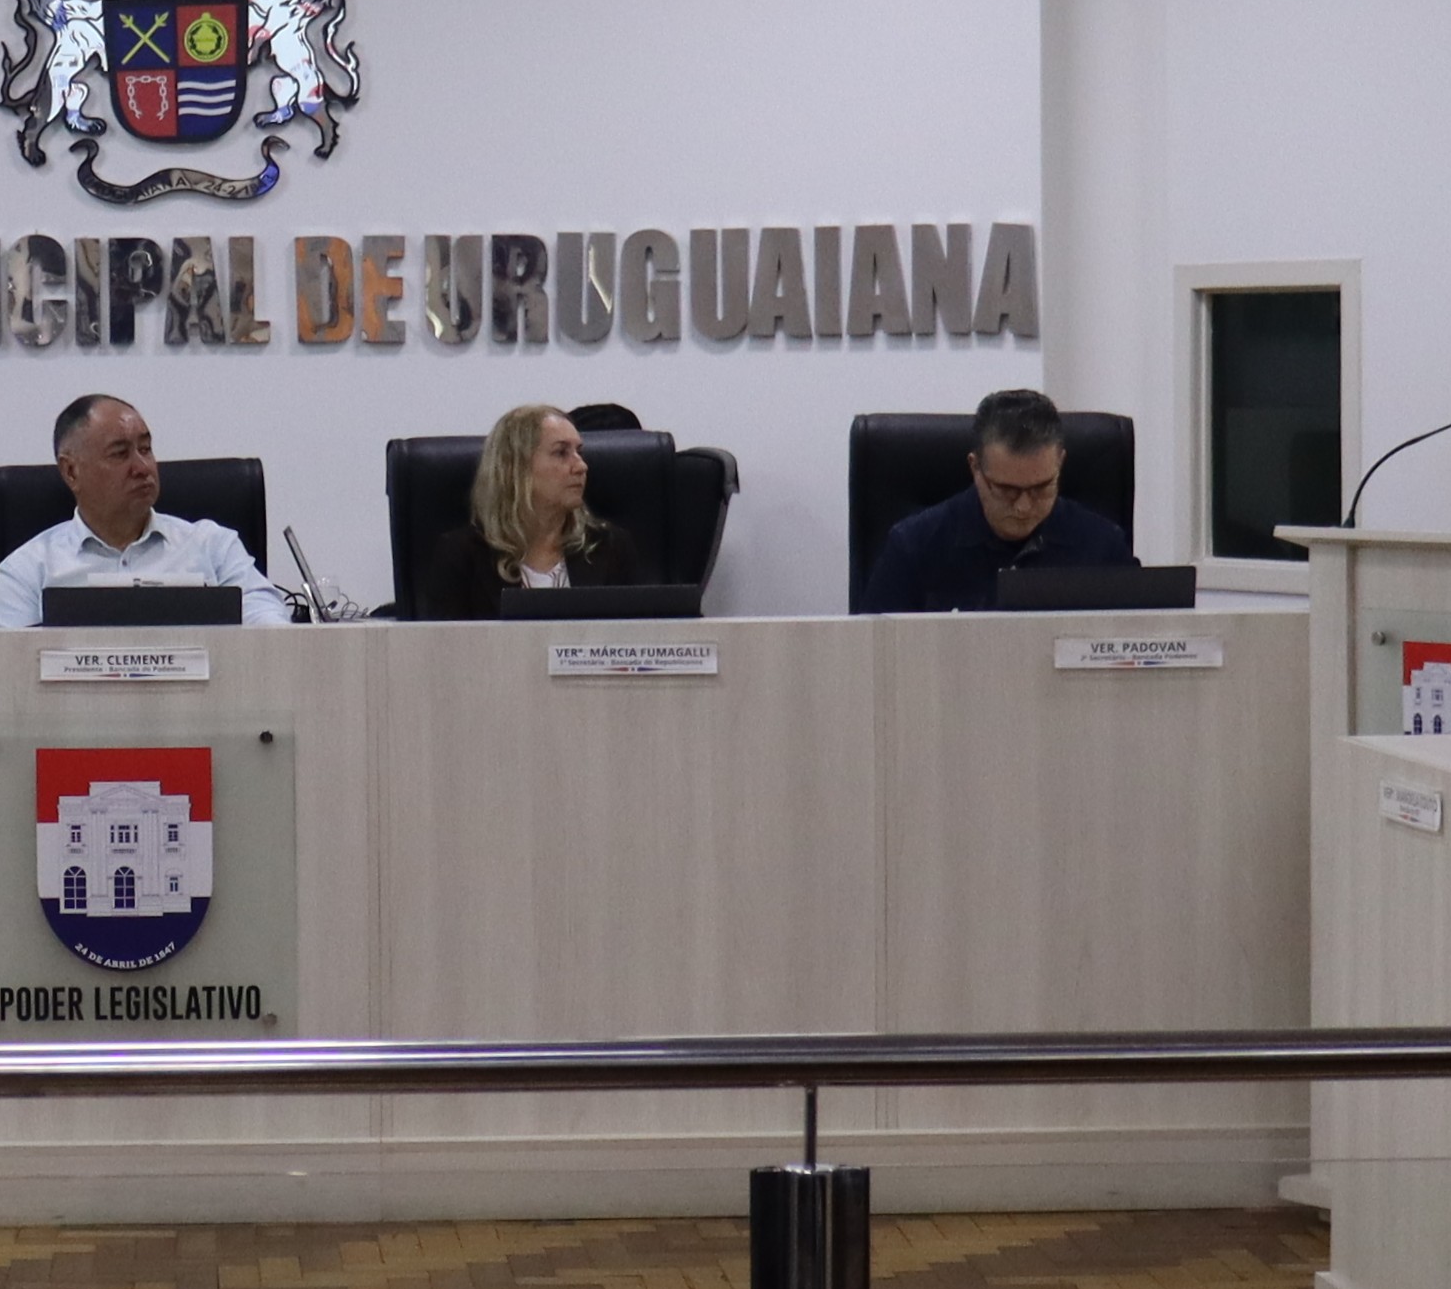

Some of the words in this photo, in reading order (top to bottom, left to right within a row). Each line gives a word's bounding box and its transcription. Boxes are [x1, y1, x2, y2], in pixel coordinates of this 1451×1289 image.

[295, 234, 406, 346] DE
[424, 222, 1040, 346] URUGUAIANA
[590, 645, 637, 657] MÁRCIA
[641, 647, 710, 657] FUMAGALLI
[1091, 642, 1118, 653] VER.
[1123, 641, 1186, 653] PADOVAN
[75, 655, 103, 666] VER.
[107, 654, 174, 666] CLEMENTE
[73, 942, 88, 956] 24
[88, 951, 103, 965] DE
[103, 959, 138, 969] ABRIL
[138, 955, 154, 968] DE
[153, 941, 177, 962] 1847
[0, 987, 84, 1022] PODER
[94, 984, 262, 1021] LEGISLATIVO
